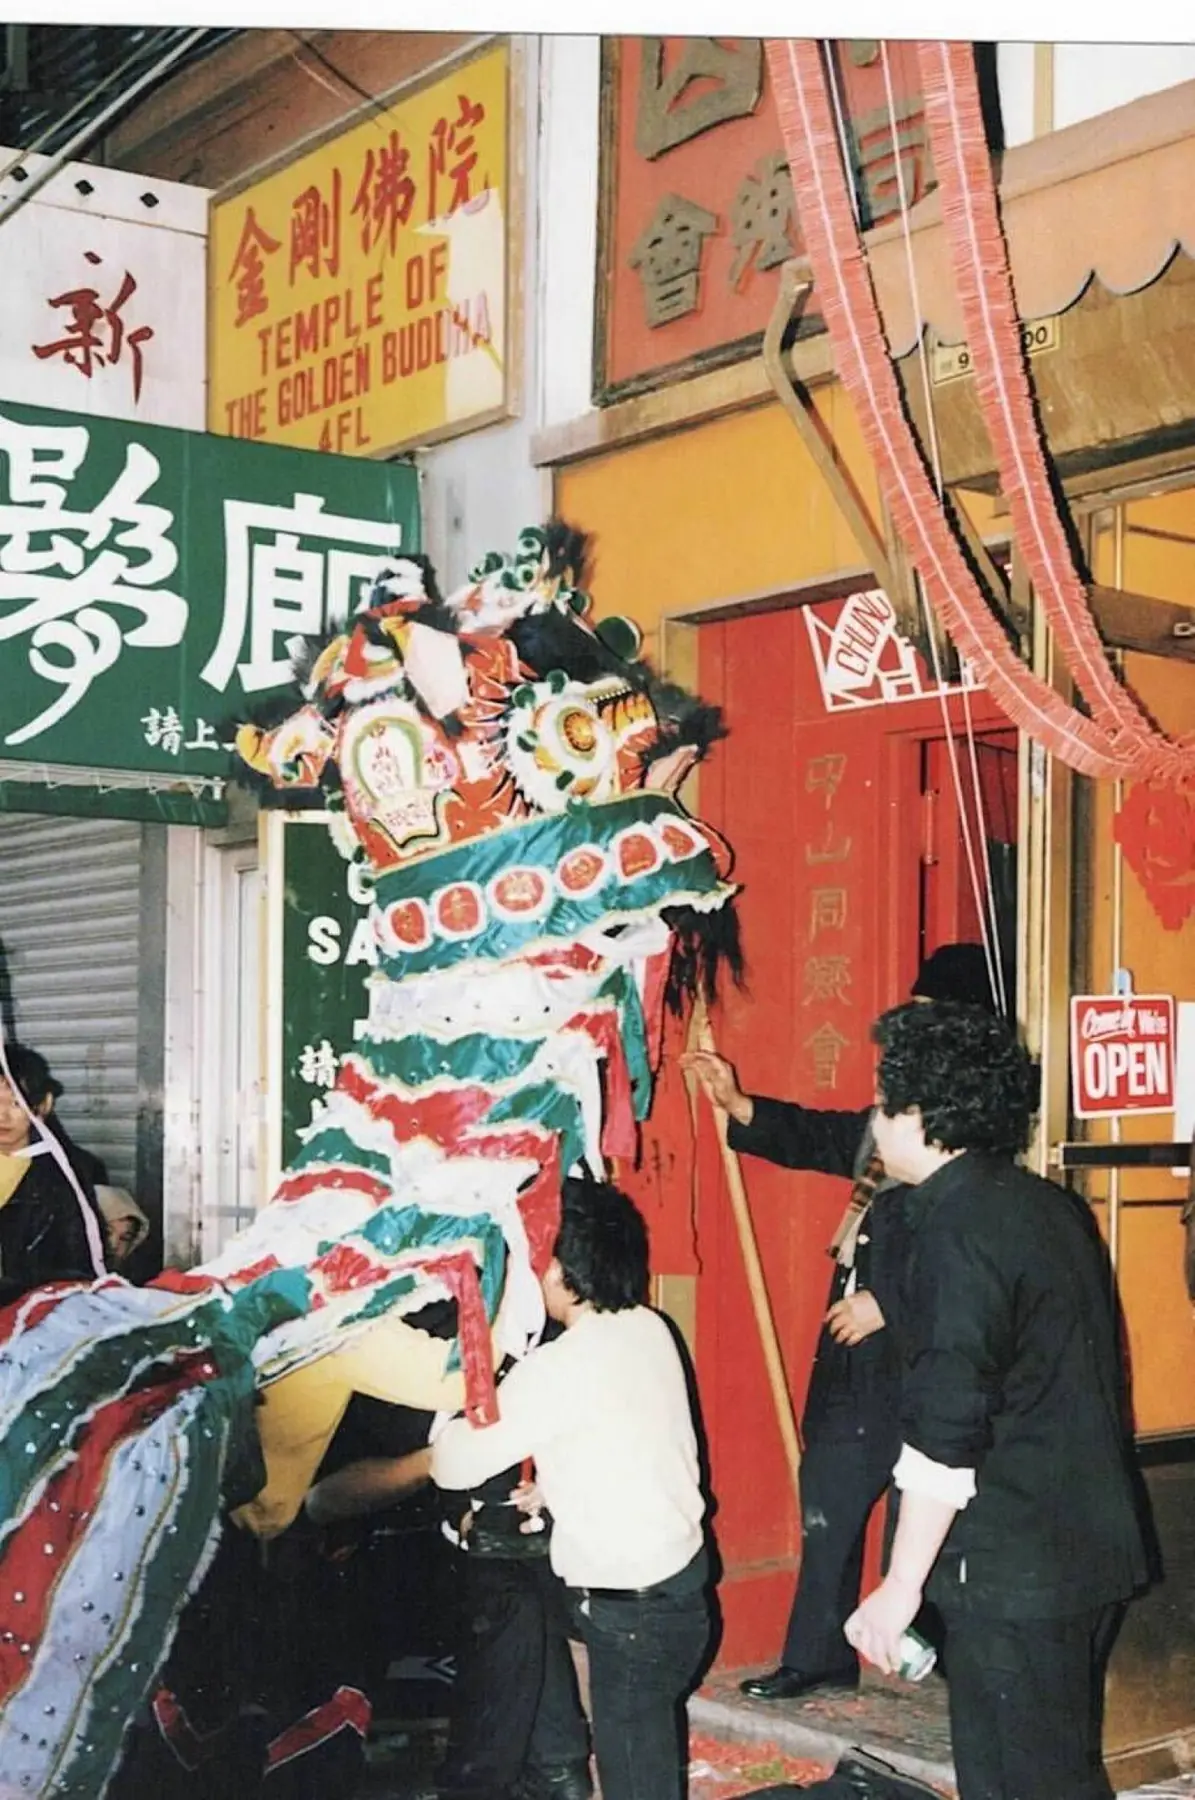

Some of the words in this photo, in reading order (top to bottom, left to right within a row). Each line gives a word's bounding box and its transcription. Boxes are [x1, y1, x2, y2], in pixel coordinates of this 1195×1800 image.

[258, 272, 384, 377] TEMPLE
[406, 242, 448, 311] OF
[225, 387, 267, 439] THE
[277, 342, 371, 427] GOLDEN
[140, 706, 236, 756] 請上
[308, 915, 378, 966] SA
[1084, 1042, 1168, 1099] OPEN
